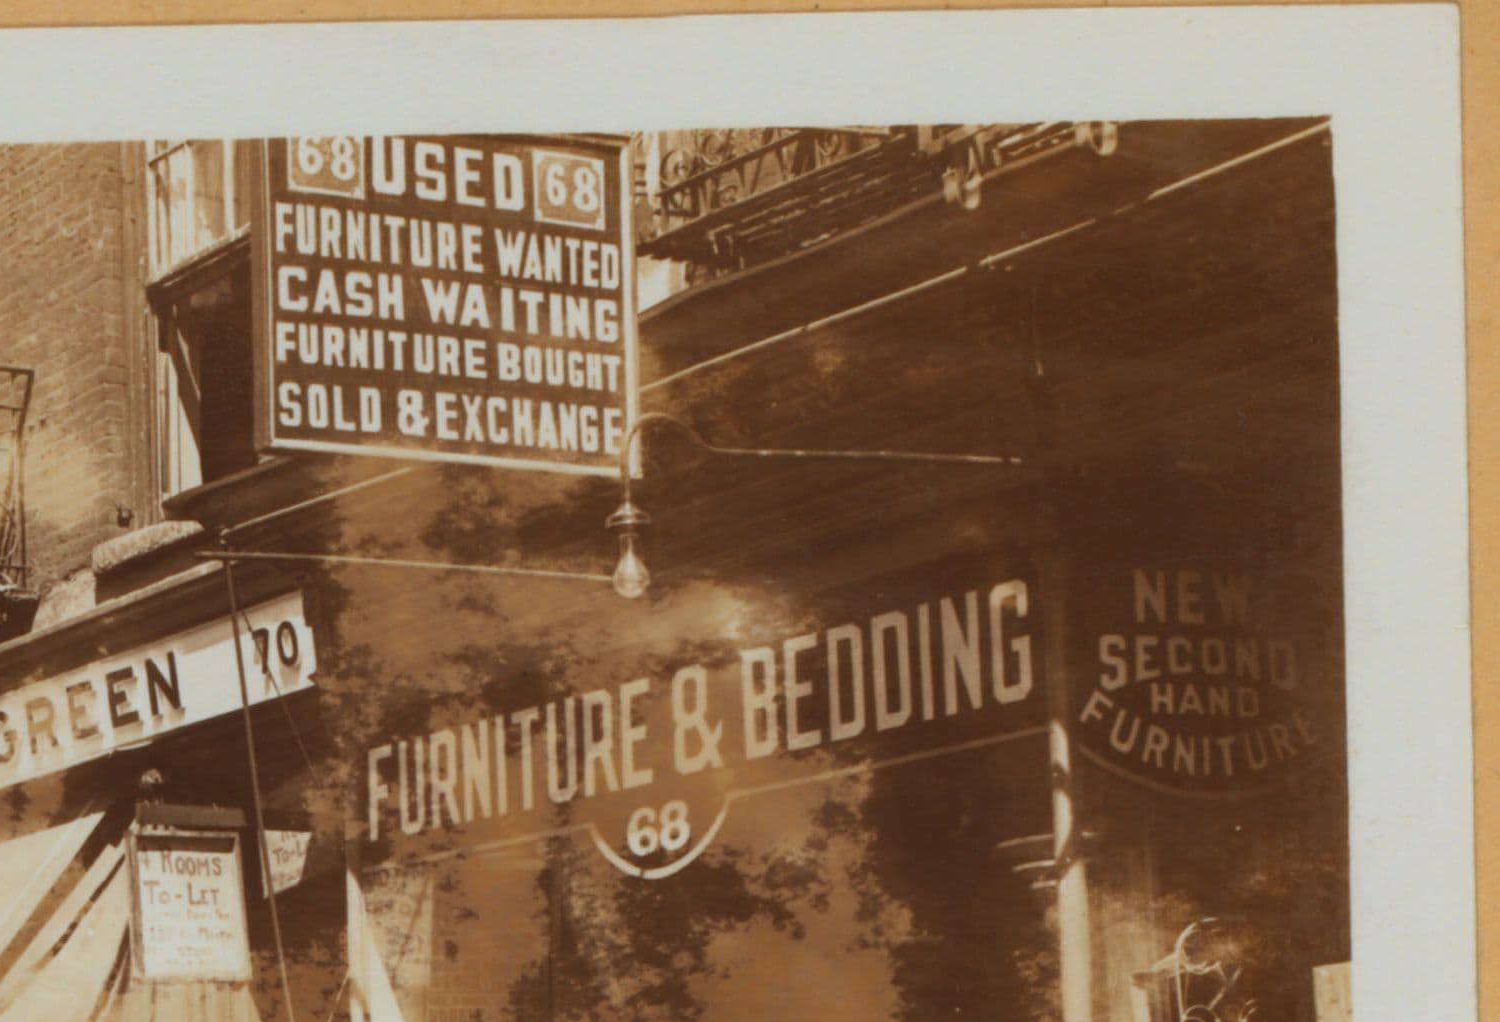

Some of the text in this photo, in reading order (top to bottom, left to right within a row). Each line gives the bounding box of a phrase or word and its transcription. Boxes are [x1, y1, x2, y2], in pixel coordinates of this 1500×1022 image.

[298, 137, 600, 213] 68 USED 68
[275, 201, 620, 291] FURNITURE WANTED
[277, 265, 620, 344] CASH WAITING
[275, 321, 622, 393] FURNITURE BOUGHT
[278, 381, 623, 456] SOLD & EXCHANGE
[1132, 568, 1248, 625] NEW
[251, 620, 299, 675] 70
[1097, 633, 1299, 692] SECOND
[367, 579, 1032, 842] FURNITURE & BEDDING
[1078, 690, 1320, 777] FURNITURE
[1150, 681, 1260, 719] HAND
[159, 849, 223, 876] ROOMS
[626, 800, 690, 857] 68
